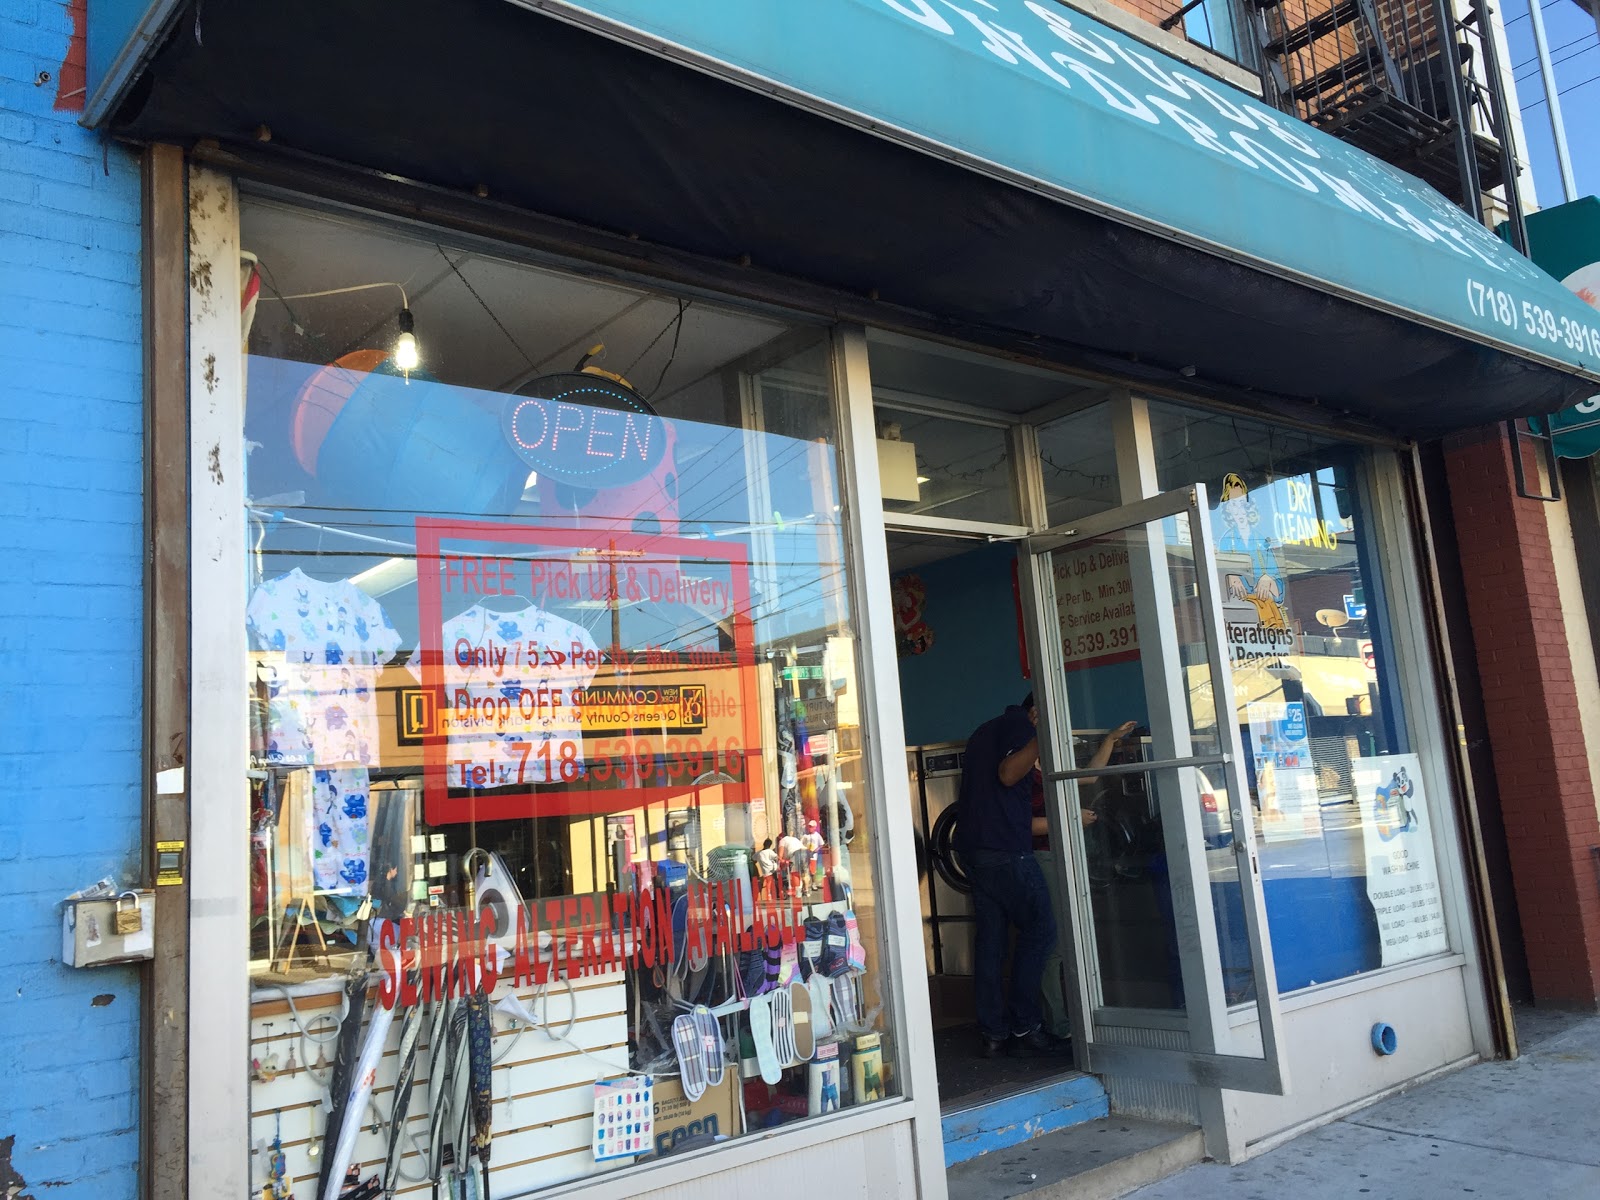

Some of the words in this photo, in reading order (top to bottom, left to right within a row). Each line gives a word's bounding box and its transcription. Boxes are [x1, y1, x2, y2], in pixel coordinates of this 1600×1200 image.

[1467, 278, 1518, 330] (718)
[1522, 301, 1600, 359] 539-3916
[512, 400, 652, 461] OPEN
[1287, 480, 1313, 514] DRY
[1273, 512, 1337, 551] CLEANING
[1073, 559, 1087, 579] Up
[1089, 555, 1097, 572] &
[1099, 549, 1130, 570] Delive
[445, 554, 515, 595] FREE
[531, 558, 581, 600] Pick
[626, 567, 642, 601] &
[648, 567, 730, 615] Delivery
[1066, 593, 1081, 607] Per
[1098, 585, 1115, 599] Min
[1067, 611, 1101, 628] Service
[455, 638, 507, 677] Only
[571, 641, 607, 669] Per
[646, 643, 679, 671] Min
[685, 643, 732, 671] 30lbs
[1063, 624, 1138, 657] 8.539.391
[454, 689, 511, 725] Drop
[519, 688, 564, 719] OFF
[454, 759, 505, 785] Tel:
[512, 736, 743, 784] 718.539.3916
[1373, 890, 1394, 900] DOUBLE
[378, 907, 499, 1012] SEWING
[514, 887, 675, 989] ALTERATION
[687, 873, 806, 961] AVAILABLE
